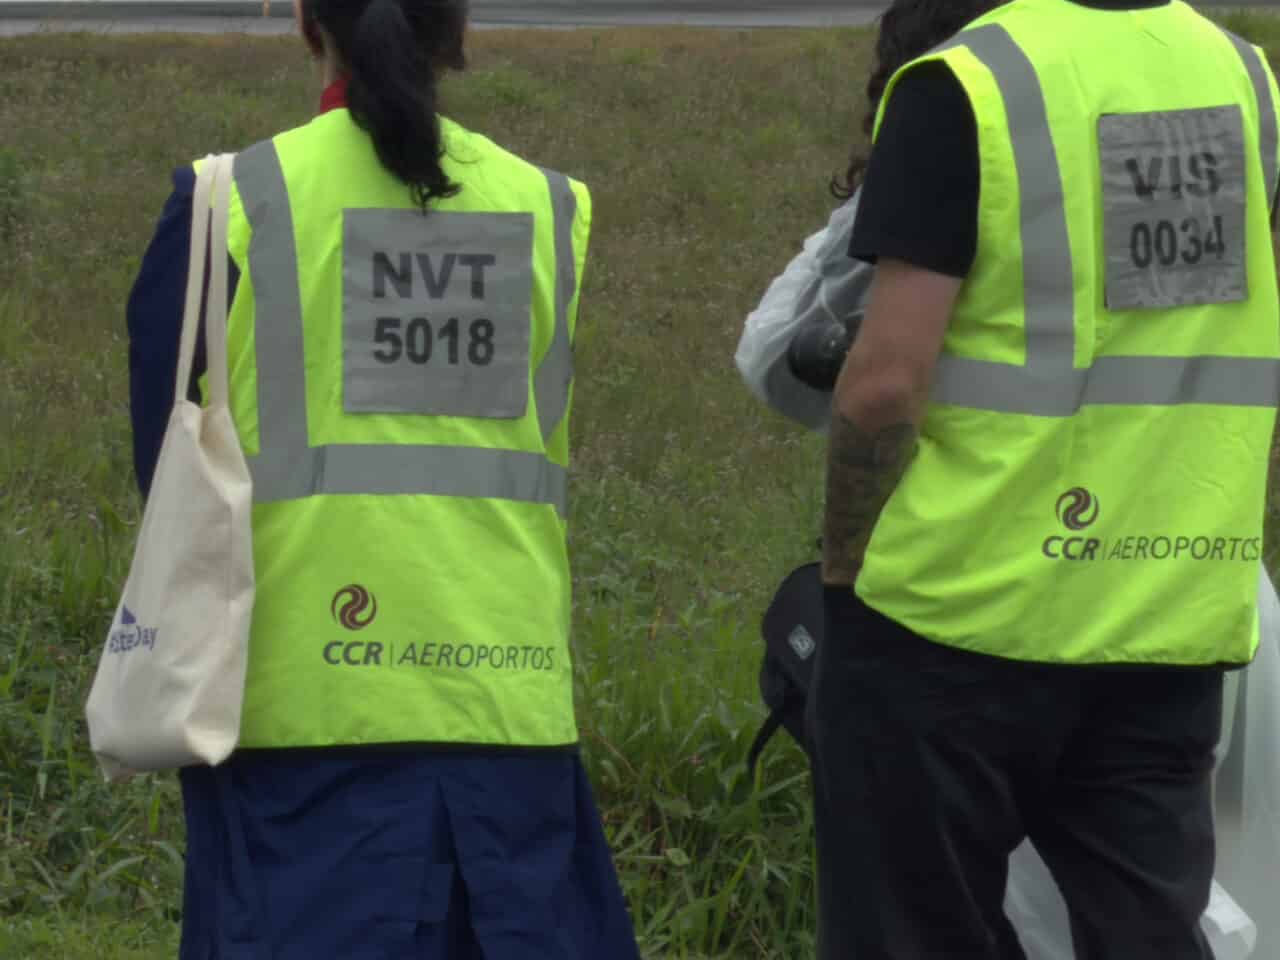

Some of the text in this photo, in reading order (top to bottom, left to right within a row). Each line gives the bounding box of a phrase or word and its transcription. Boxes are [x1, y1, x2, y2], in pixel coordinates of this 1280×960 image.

[1125, 152, 1221, 200] VIS
[1130, 216, 1225, 269] 0034
[372, 251, 496, 300] NVT
[373, 317, 495, 366] 5018
[1042, 536, 1100, 561] CCR
[323, 641, 556, 670] CCR AEROPORTOS
